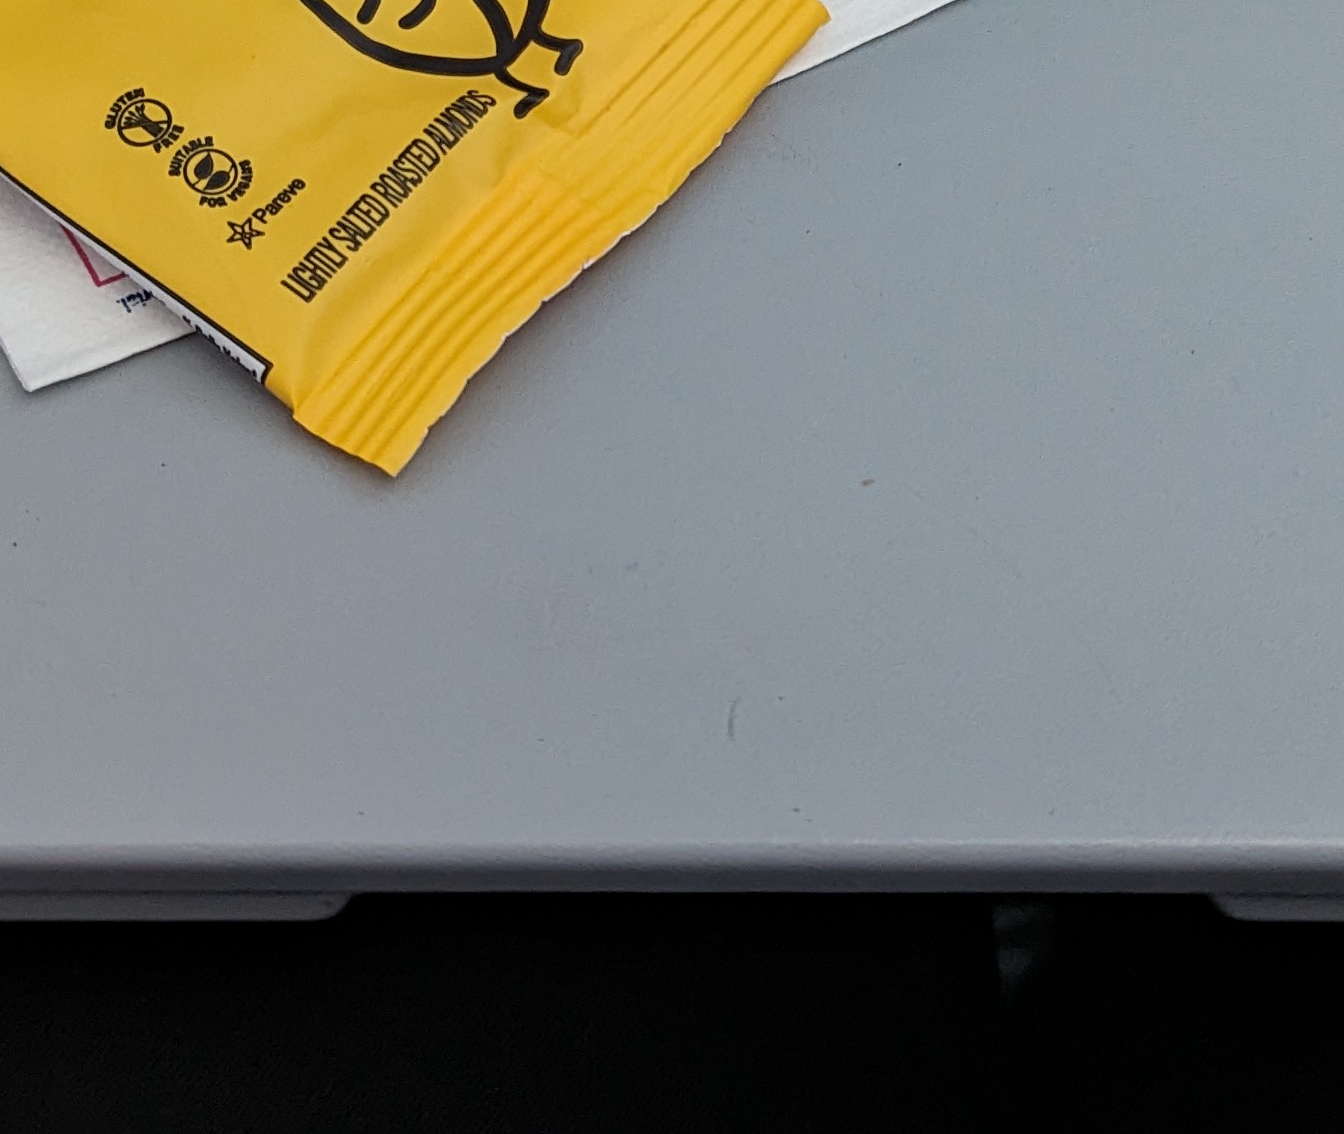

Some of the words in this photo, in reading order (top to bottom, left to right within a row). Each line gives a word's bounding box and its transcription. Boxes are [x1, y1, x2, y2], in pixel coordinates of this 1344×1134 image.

[104, 87, 145, 130] GLUTEN
[152, 124, 185, 153] FREE
[168, 136, 214, 177] SUITABLE
[199, 195, 228, 208] FOR
[252, 178, 306, 224] Pareve
[280, 236, 349, 303] LIGHTLY
[328, 193, 390, 252] SALTED
[370, 138, 441, 208] ROASTED
[423, 89, 497, 156] ALMONDS
